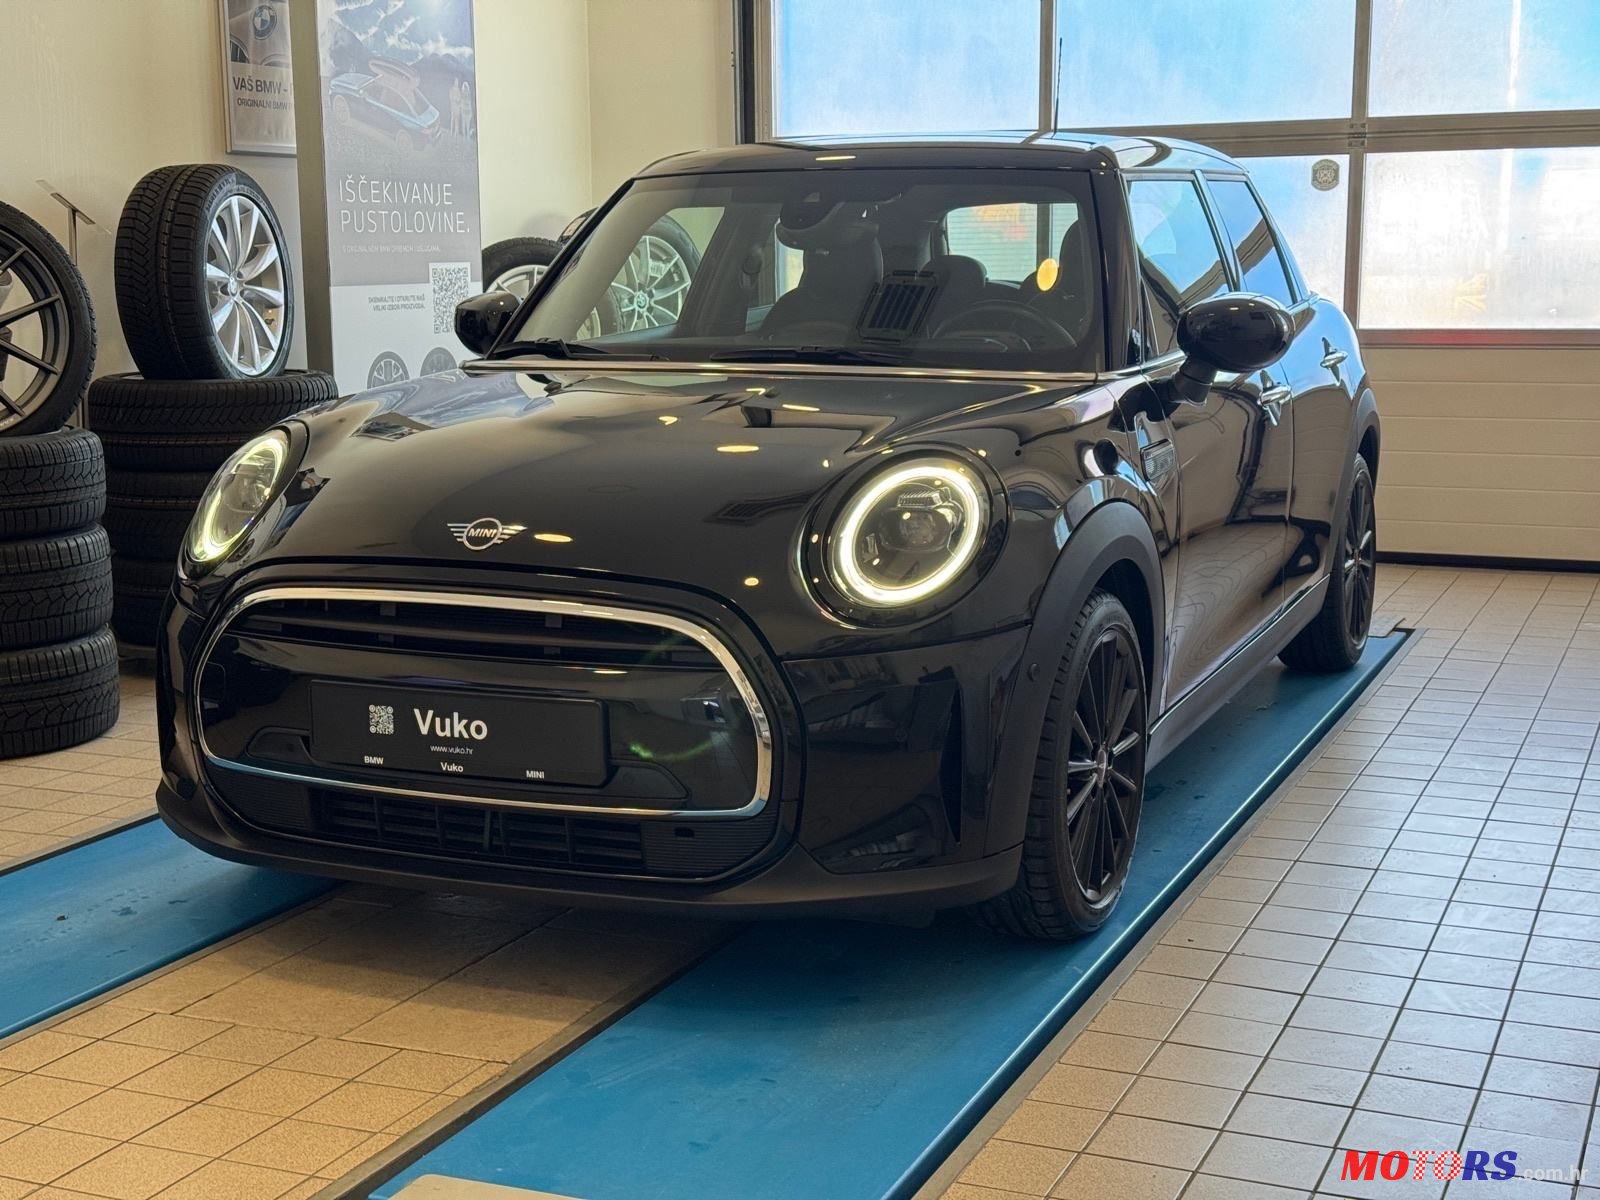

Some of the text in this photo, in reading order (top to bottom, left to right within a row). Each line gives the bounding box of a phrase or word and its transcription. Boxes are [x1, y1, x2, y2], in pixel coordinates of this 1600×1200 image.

[232, 75, 254, 92] VAŠ
[255, 79, 282, 95] BMW
[339, 174, 453, 207] IŠČEKIVANJE
[340, 209, 470, 233] PUSTOLOVINE.
[468, 527, 498, 539] MINI
[413, 707, 488, 741] Vuko
[430, 744, 474, 755] www.vuko.hr
[364, 755, 545, 779] BMW Vuko MINI
